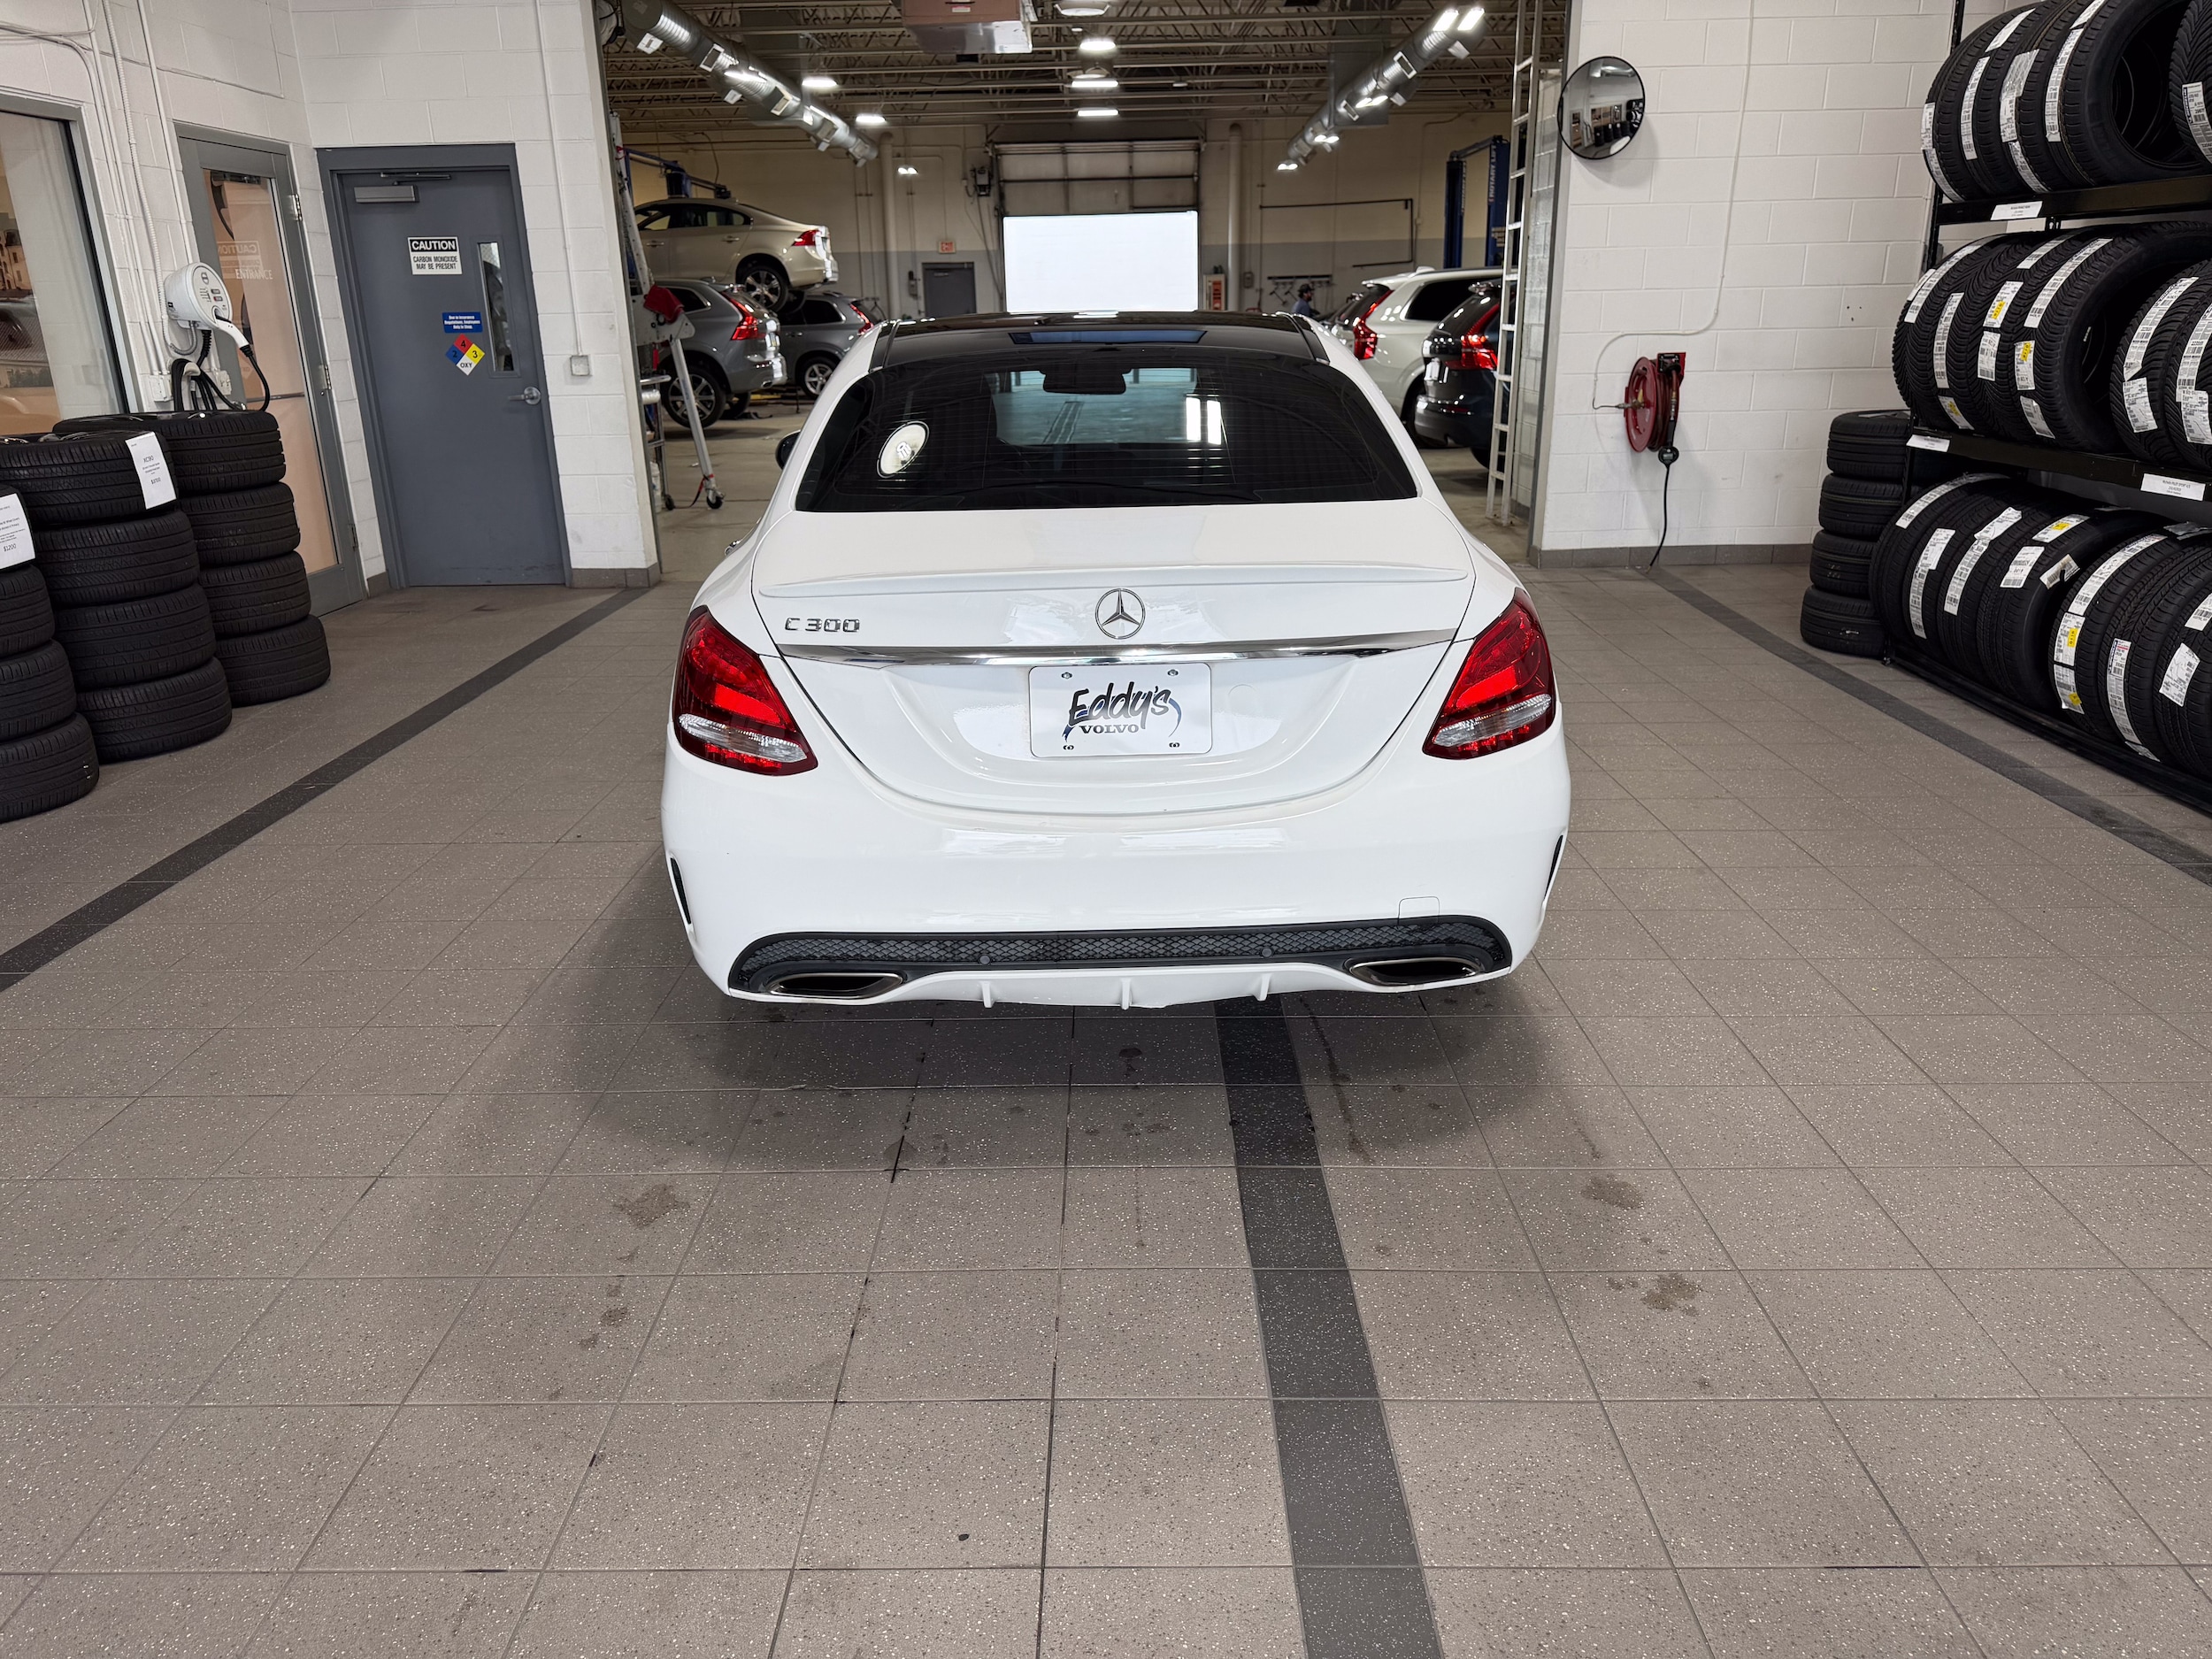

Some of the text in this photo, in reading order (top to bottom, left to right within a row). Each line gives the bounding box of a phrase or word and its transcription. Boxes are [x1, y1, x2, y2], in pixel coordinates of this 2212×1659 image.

[411, 241, 456, 250] CAUTION
[234, 268, 273, 280] ENTRANCE
[4, 543, 17, 552] $1200
[785, 618, 860, 632] C 300
[1069, 681, 1171, 730] Eddy's
[1079, 724, 1140, 733] VOLVO
